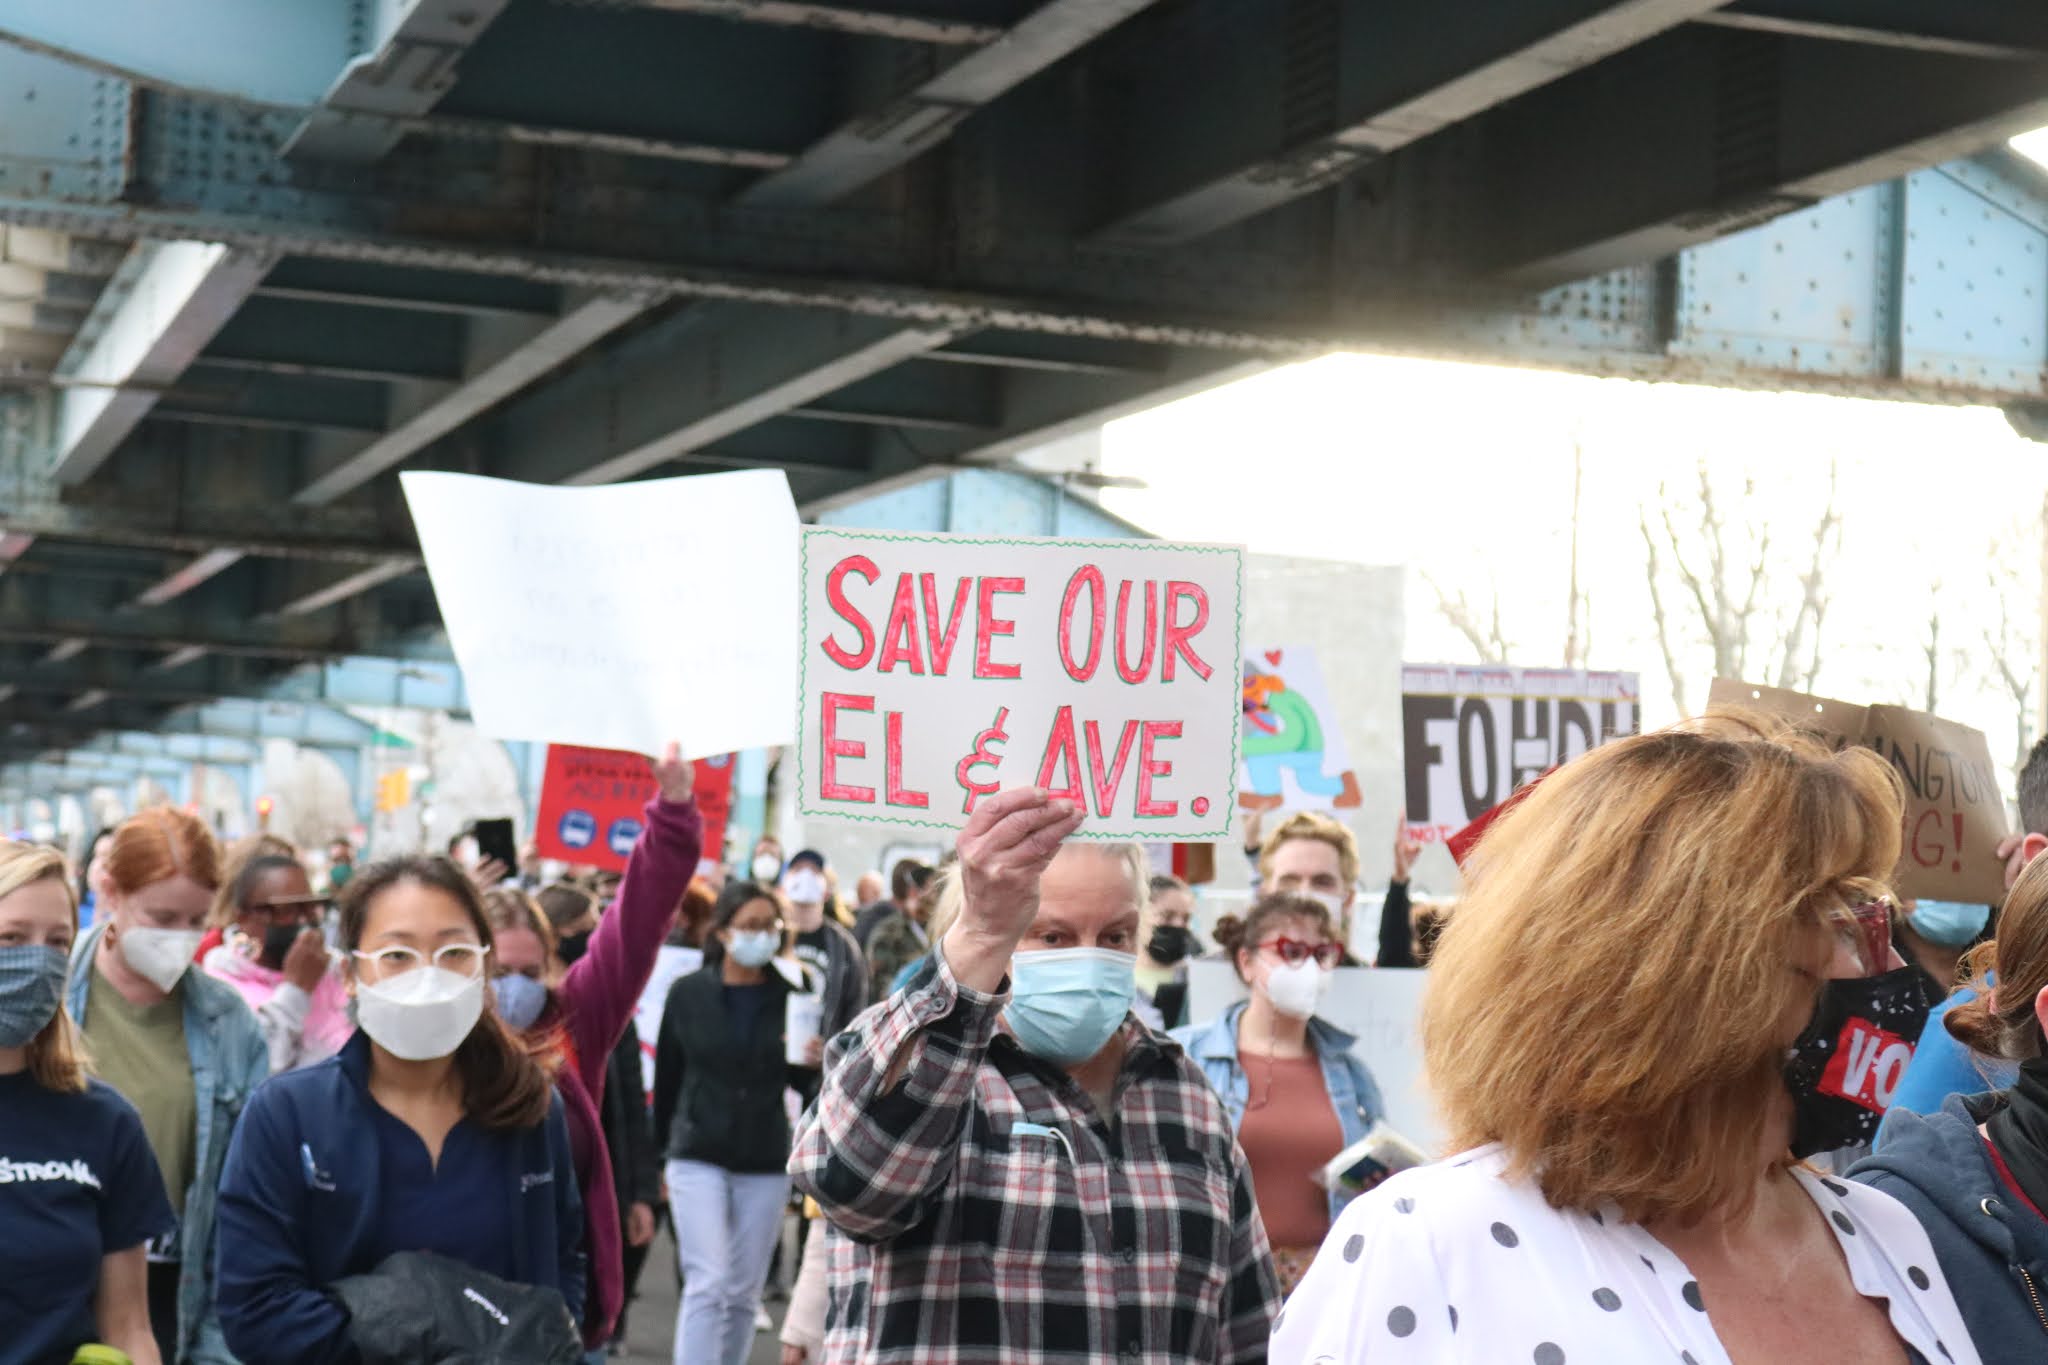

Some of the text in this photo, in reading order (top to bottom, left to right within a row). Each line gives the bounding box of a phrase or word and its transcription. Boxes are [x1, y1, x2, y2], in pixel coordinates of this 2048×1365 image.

[820, 553, 1215, 685] SAVE OUR
[819, 690, 1211, 820] EL & AVE.
